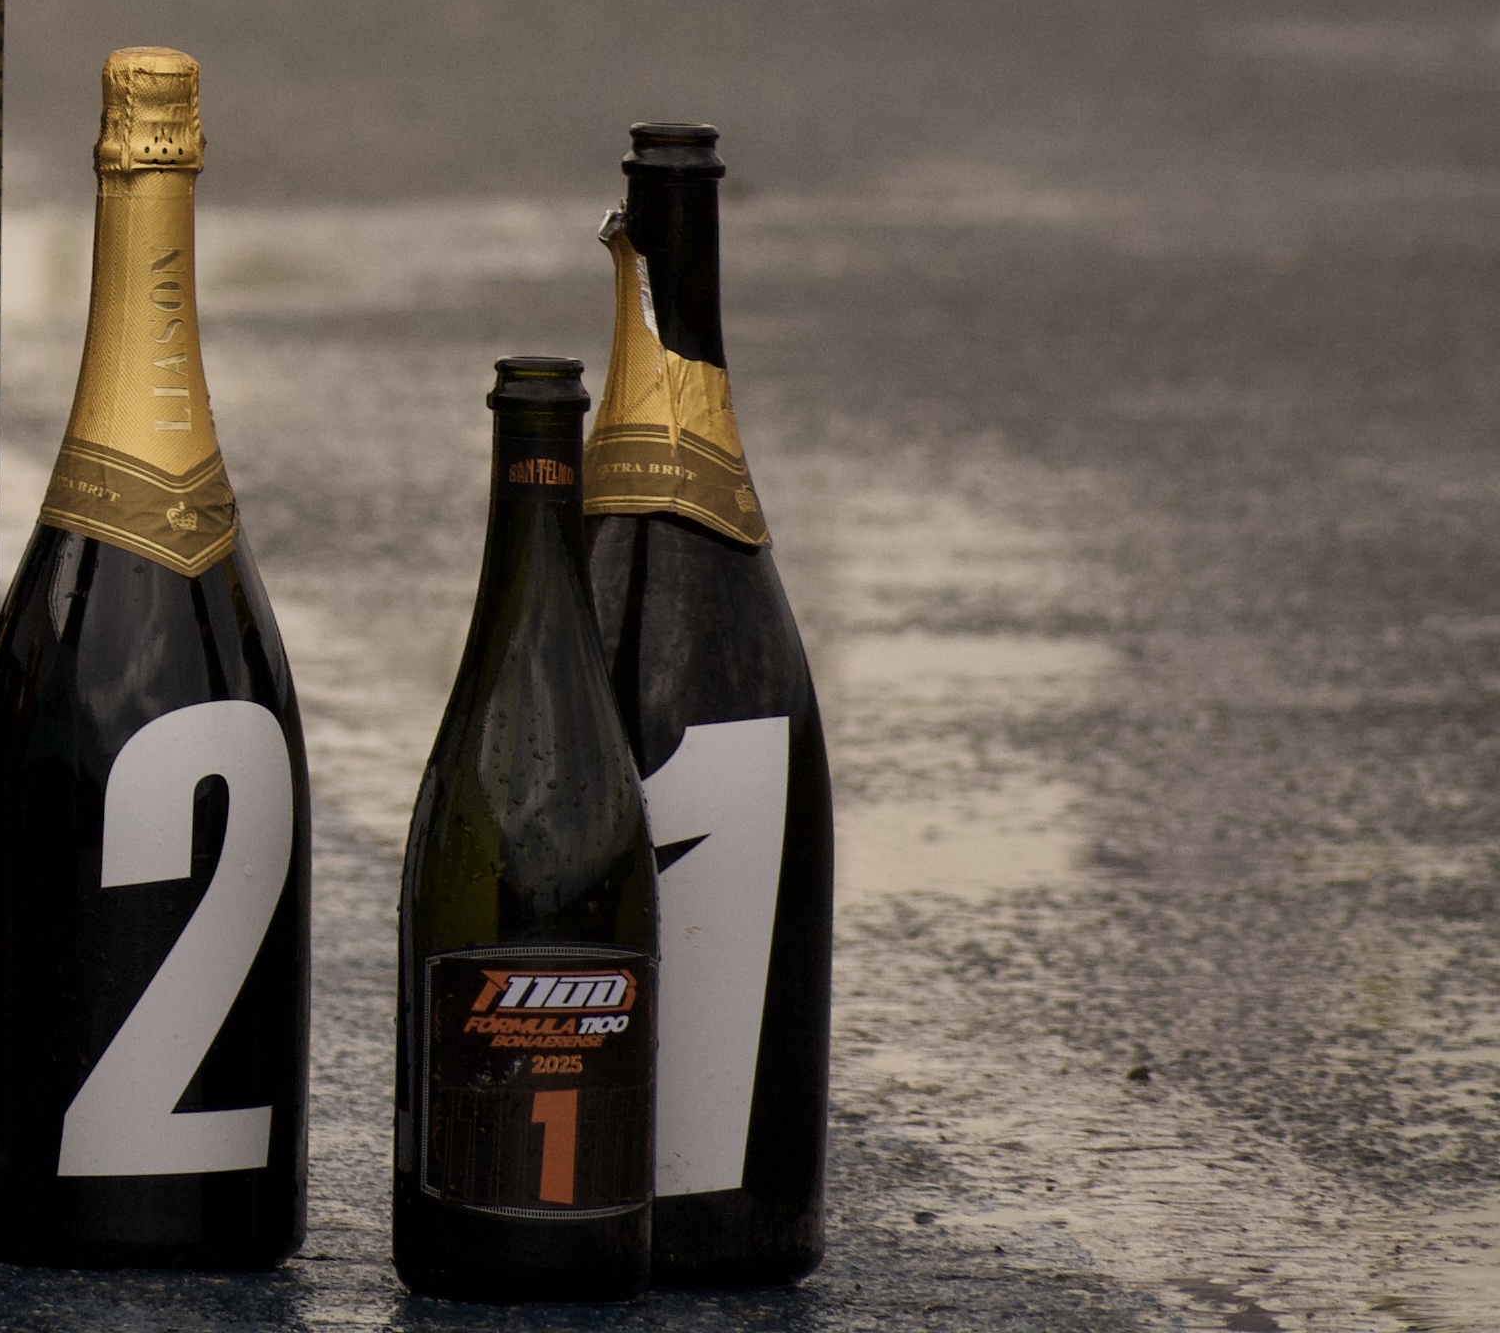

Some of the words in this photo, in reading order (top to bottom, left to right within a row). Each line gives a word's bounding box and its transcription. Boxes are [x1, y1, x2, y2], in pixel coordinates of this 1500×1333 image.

[150, 247, 192, 431] LIASON
[509, 458, 534, 484] SAN
[536, 458, 574, 485] TELMO
[649, 463, 697, 481] BRUT
[58, 701, 294, 1176] 2
[640, 716, 789, 1197] 1
[463, 1013, 576, 1034] FÓRMULA
[578, 1015, 629, 1034] 1100
[490, 1035, 605, 1048] BONAERENSE
[531, 1054, 582, 1074] 2025
[531, 1089, 577, 1204] 1
